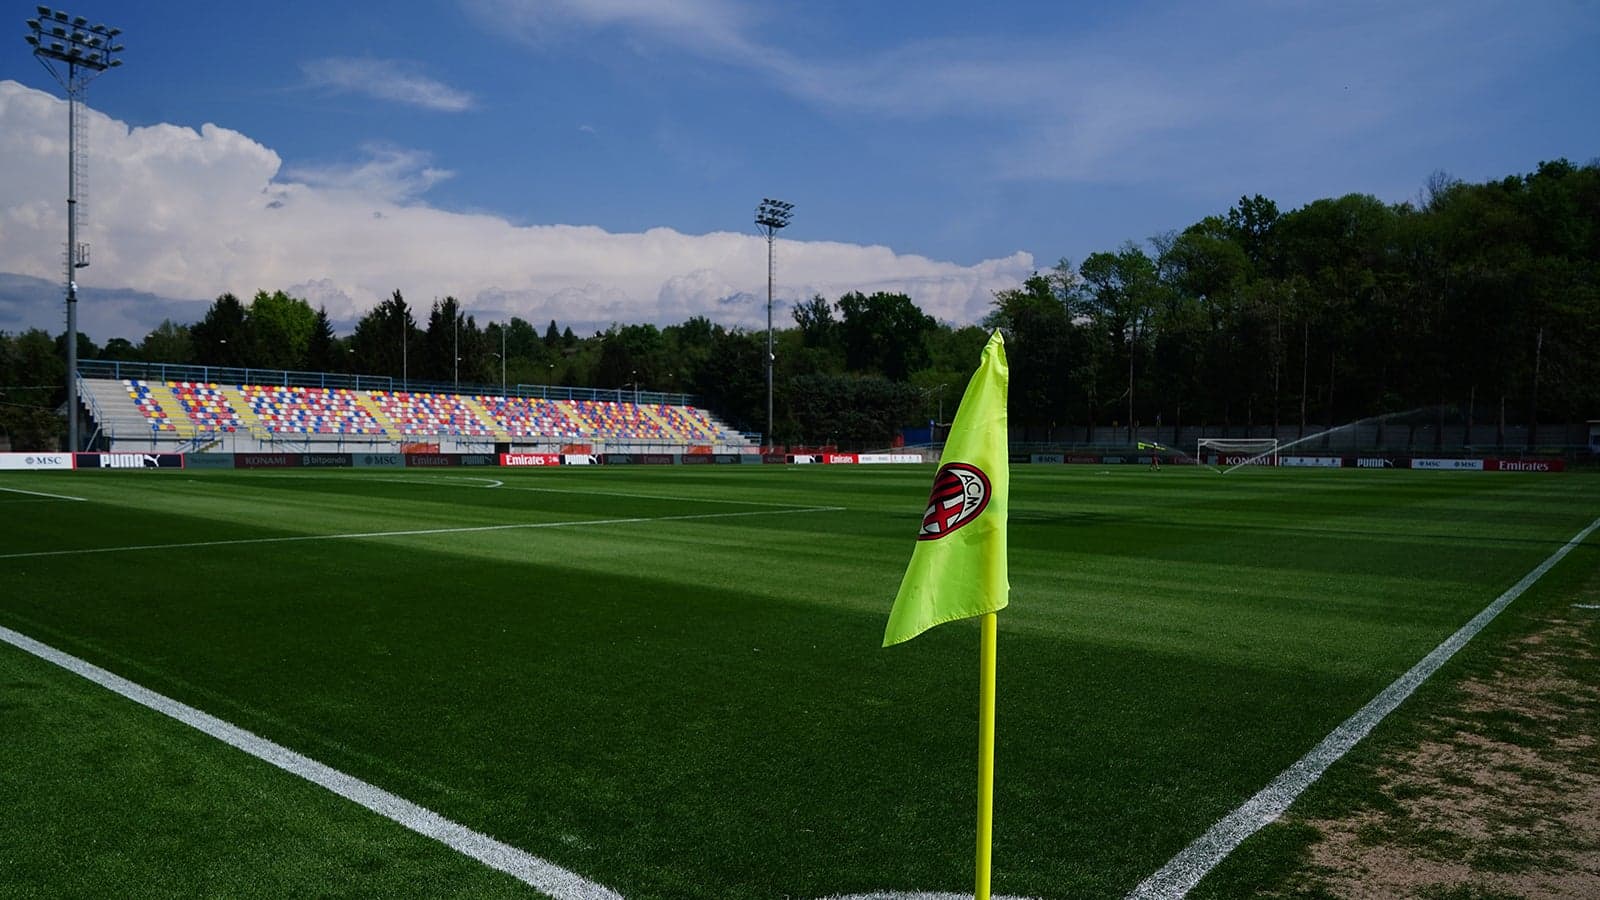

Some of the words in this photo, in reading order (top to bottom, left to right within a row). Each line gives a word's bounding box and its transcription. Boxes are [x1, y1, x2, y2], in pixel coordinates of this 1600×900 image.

[36, 456, 63, 465] MSC
[100, 454, 145, 468] PUMA
[245, 456, 287, 465] KONAMI
[374, 455, 397, 465] MSC
[412, 455, 449, 465] Emirates
[505, 454, 545, 466] Emirates
[1225, 456, 1270, 465] KONAMI
[1357, 458, 1384, 468] PUMA
[1499, 460, 1549, 472] Emirates
[960, 474, 982, 512] ACM
